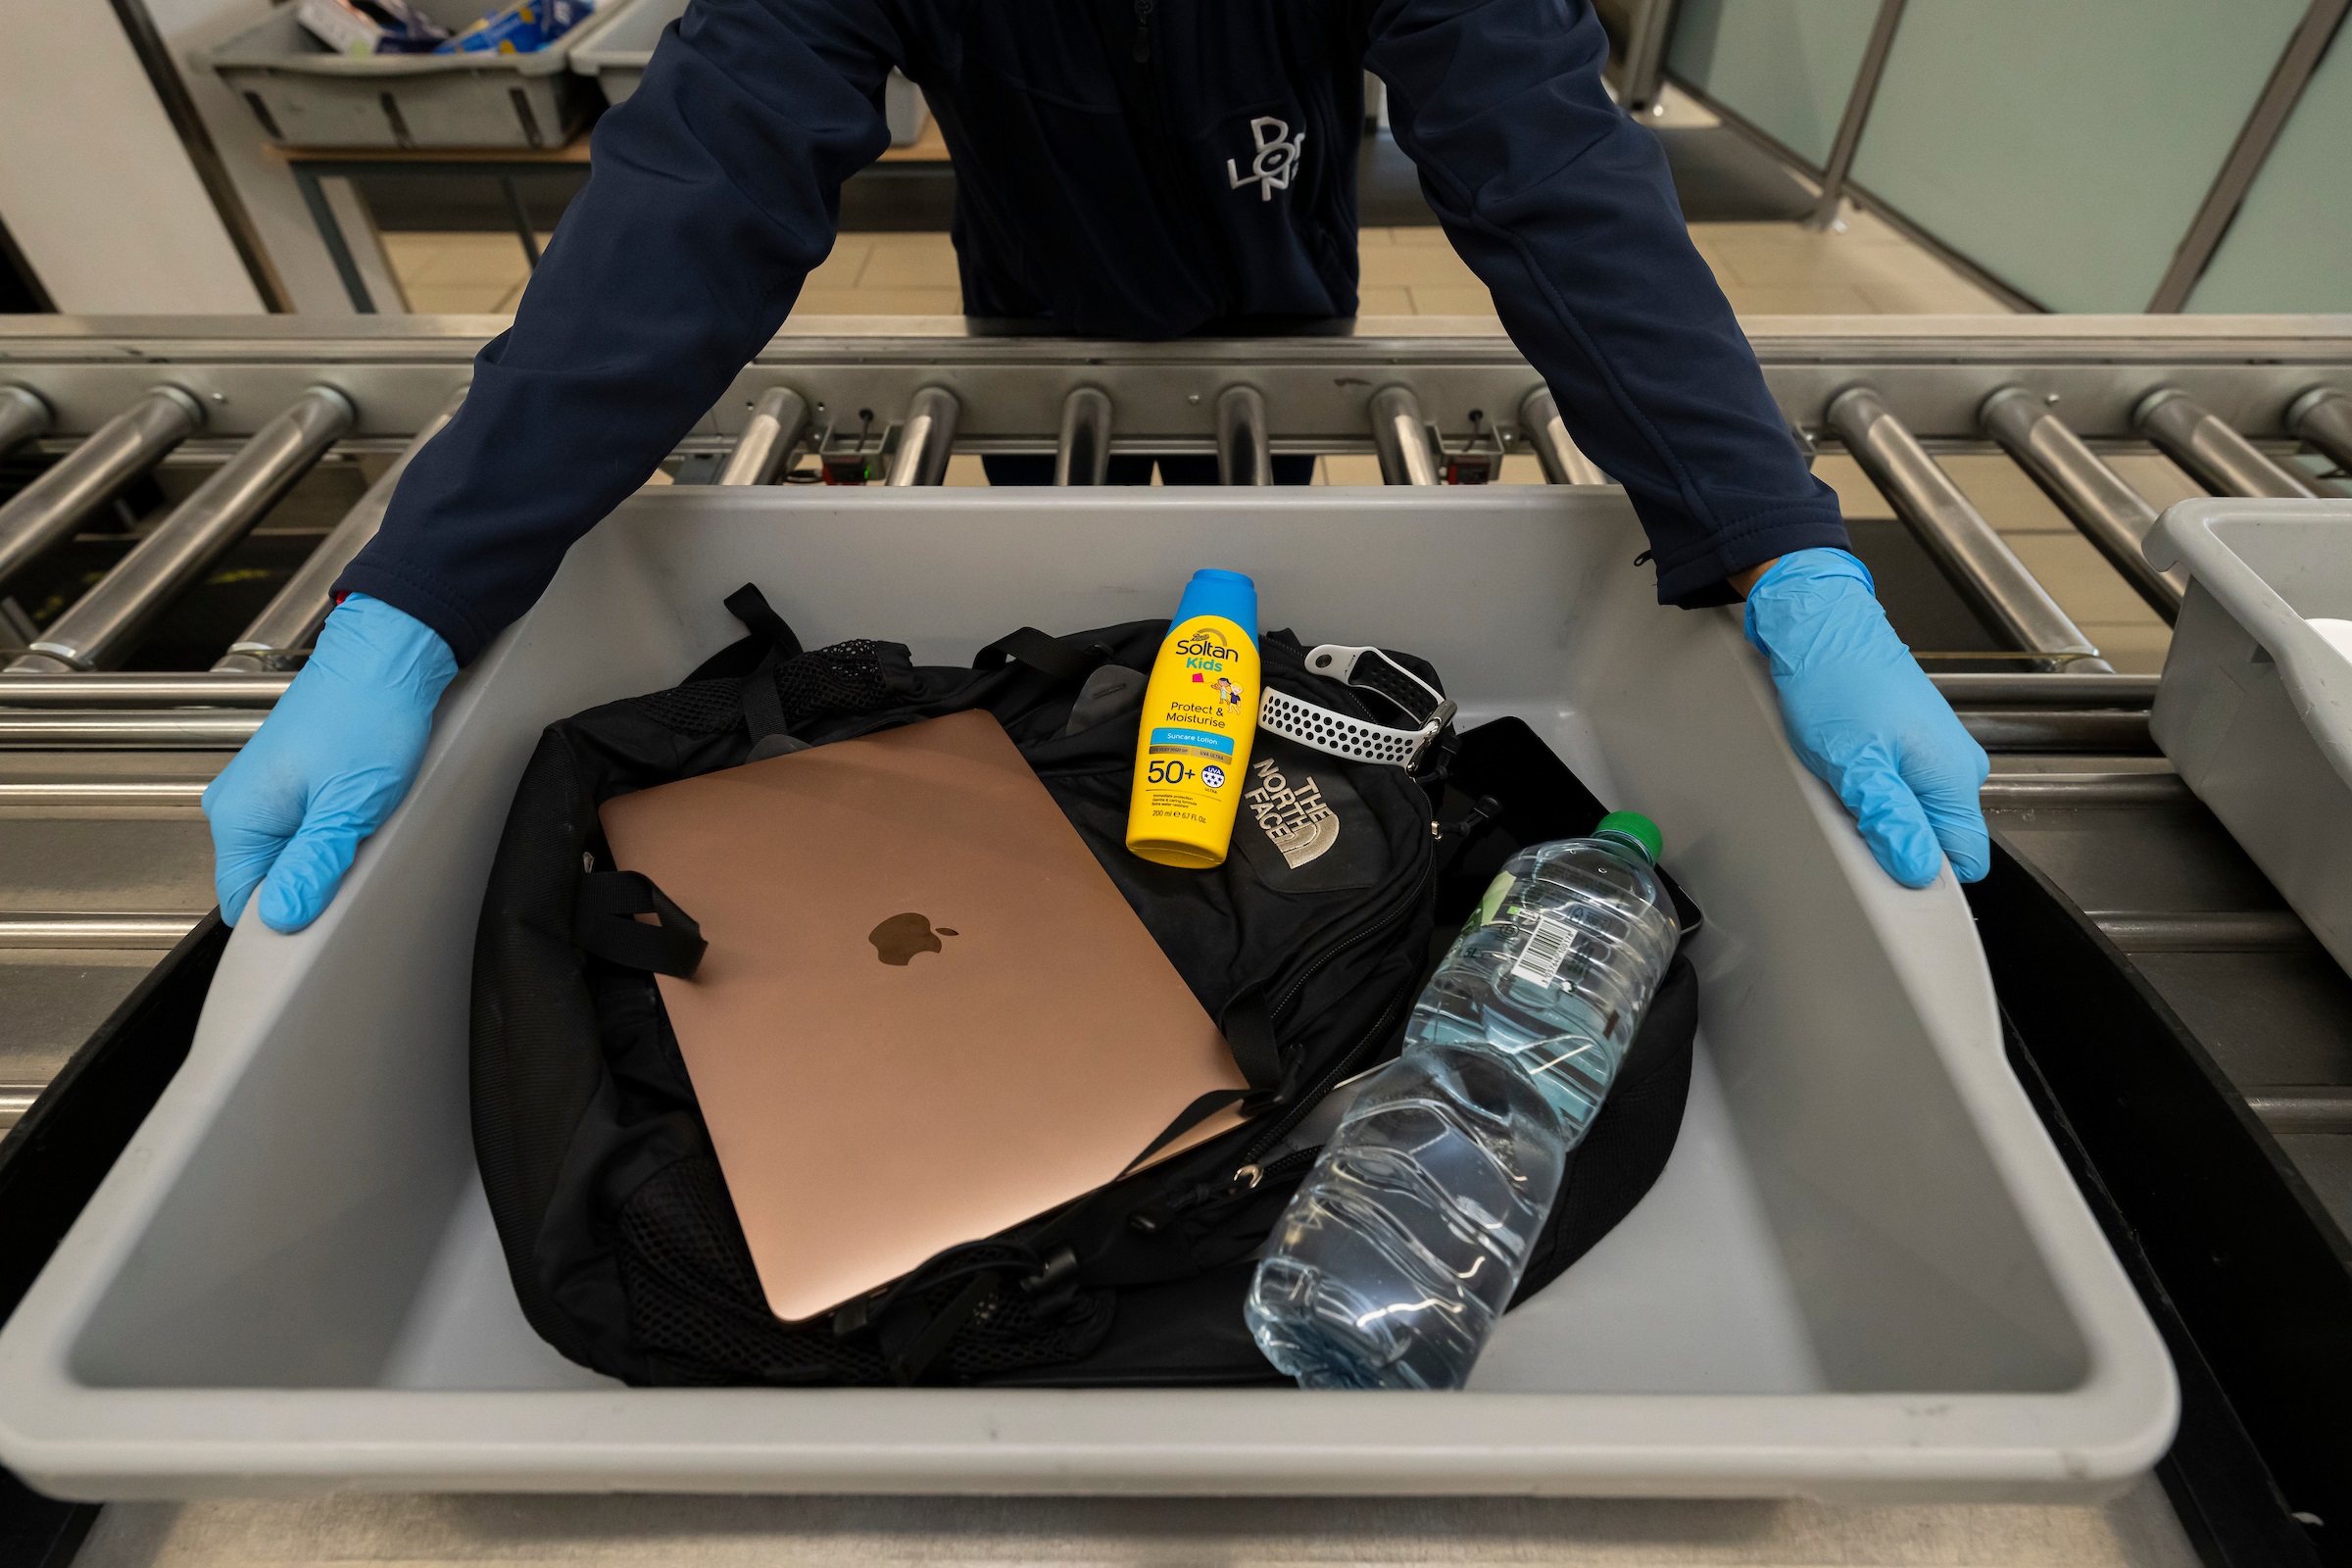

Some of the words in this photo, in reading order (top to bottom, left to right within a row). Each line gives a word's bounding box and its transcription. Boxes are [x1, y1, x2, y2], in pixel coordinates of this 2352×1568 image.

[1176, 640, 1239, 662] Soltan
[1186, 657, 1223, 672] Kids
[1171, 702, 1212, 714] Protect
[1216, 708, 1224, 716] &
[1166, 712, 1226, 728] Moisturise
[1167, 732, 1196, 741] Suncare
[1197, 736, 1218, 745] Lotion
[1148, 760, 1196, 784] 50+
[1207, 766, 1222, 775] UVA
[1252, 758, 1314, 832] NORTH
[1294, 775, 1334, 822] THE
[1244, 787, 1291, 839] FACE
